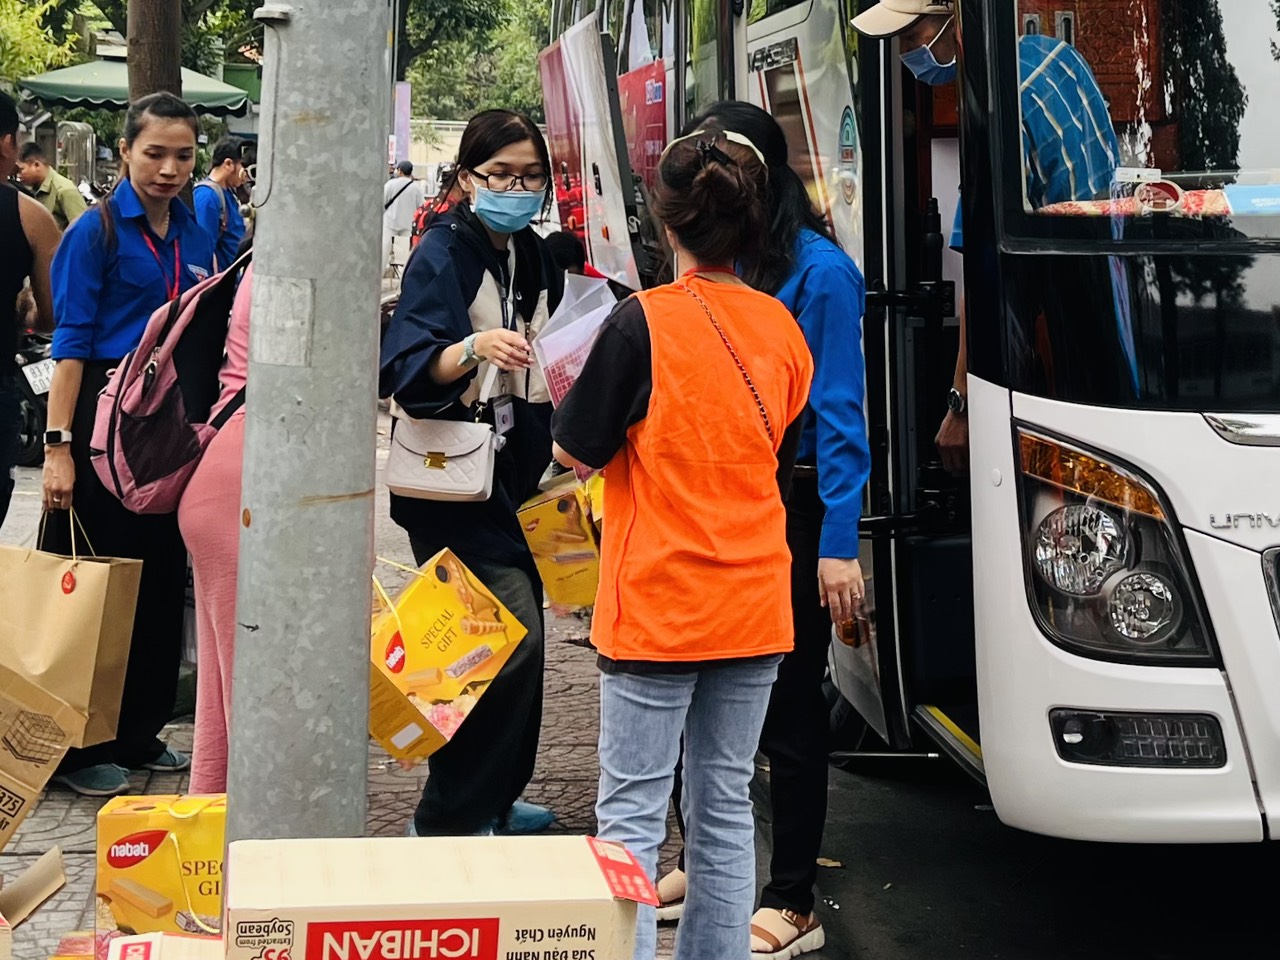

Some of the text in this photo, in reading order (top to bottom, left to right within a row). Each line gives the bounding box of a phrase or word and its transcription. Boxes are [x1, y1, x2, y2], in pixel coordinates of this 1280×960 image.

[420, 607, 455, 650] SPECIAL
[437, 626, 459, 653] GIFT
[111, 841, 149, 858] nabati
[181, 860, 223, 877] SPE
[240, 921, 292, 937] Soybean
[515, 924, 596, 945] Nguyên Chất
[322, 928, 480, 960] ICHIBAN
